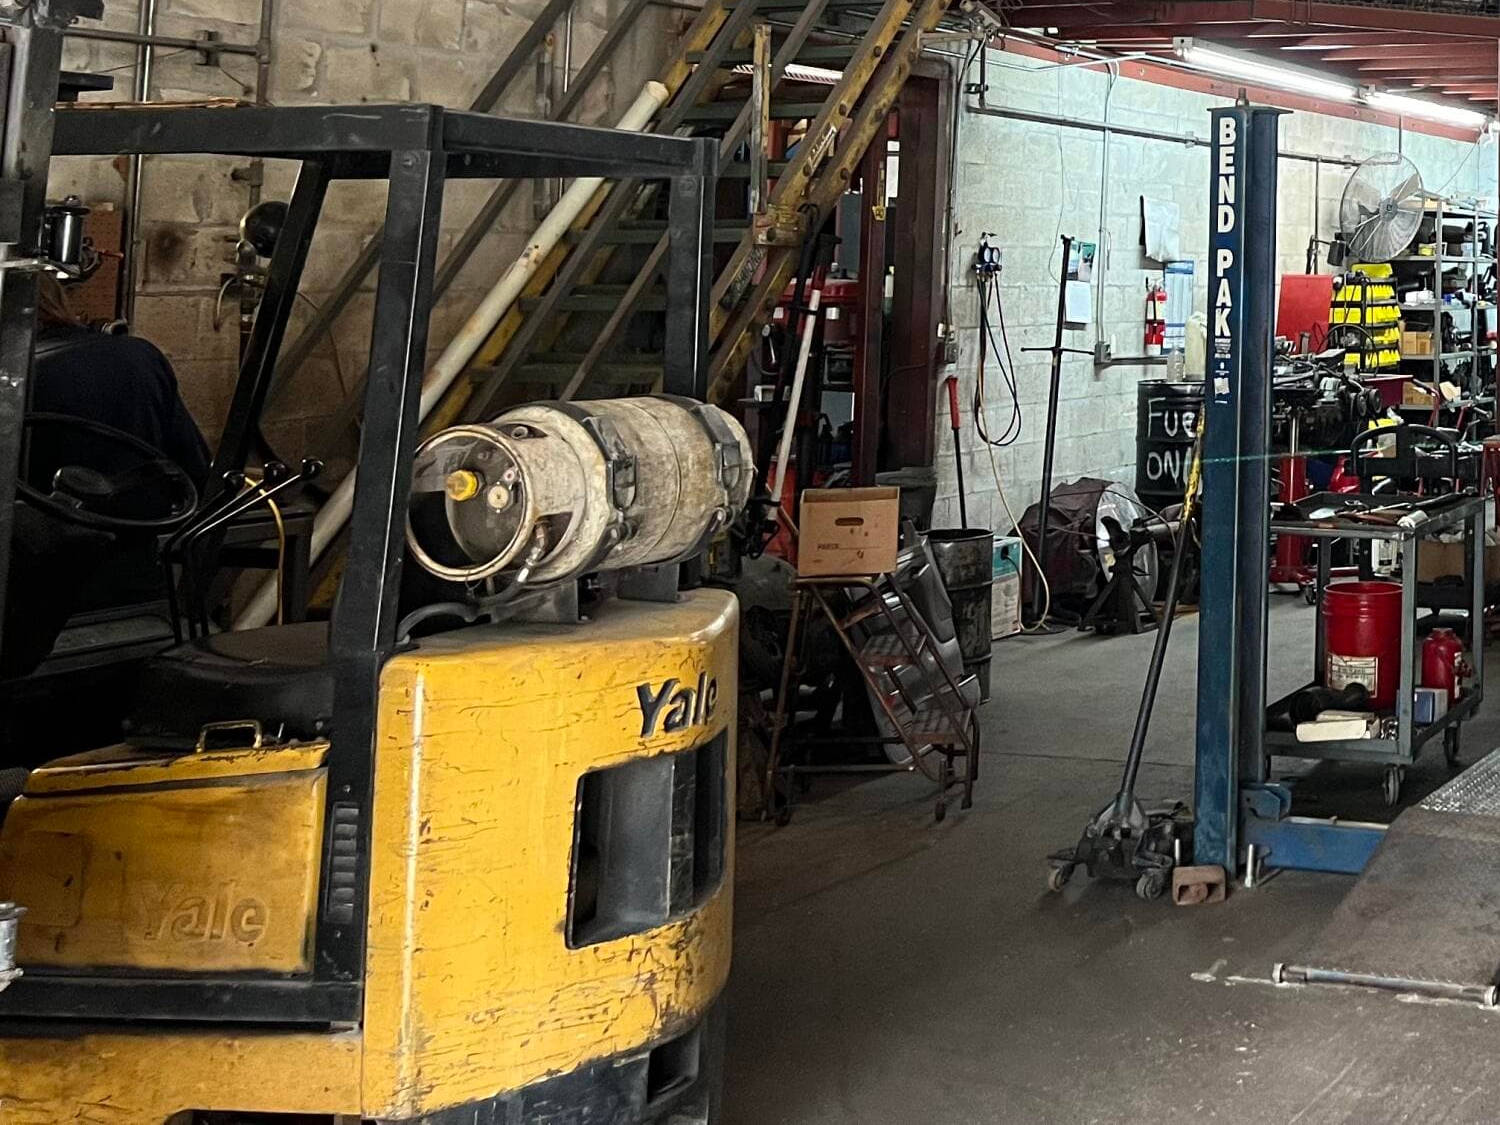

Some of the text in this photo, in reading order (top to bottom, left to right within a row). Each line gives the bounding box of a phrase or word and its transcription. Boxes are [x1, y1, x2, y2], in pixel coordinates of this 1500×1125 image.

[1217, 116, 1237, 234] BEND
[1213, 248, 1234, 337] PAK
[636, 670, 719, 739] Yale
[139, 878, 271, 945] Yale
